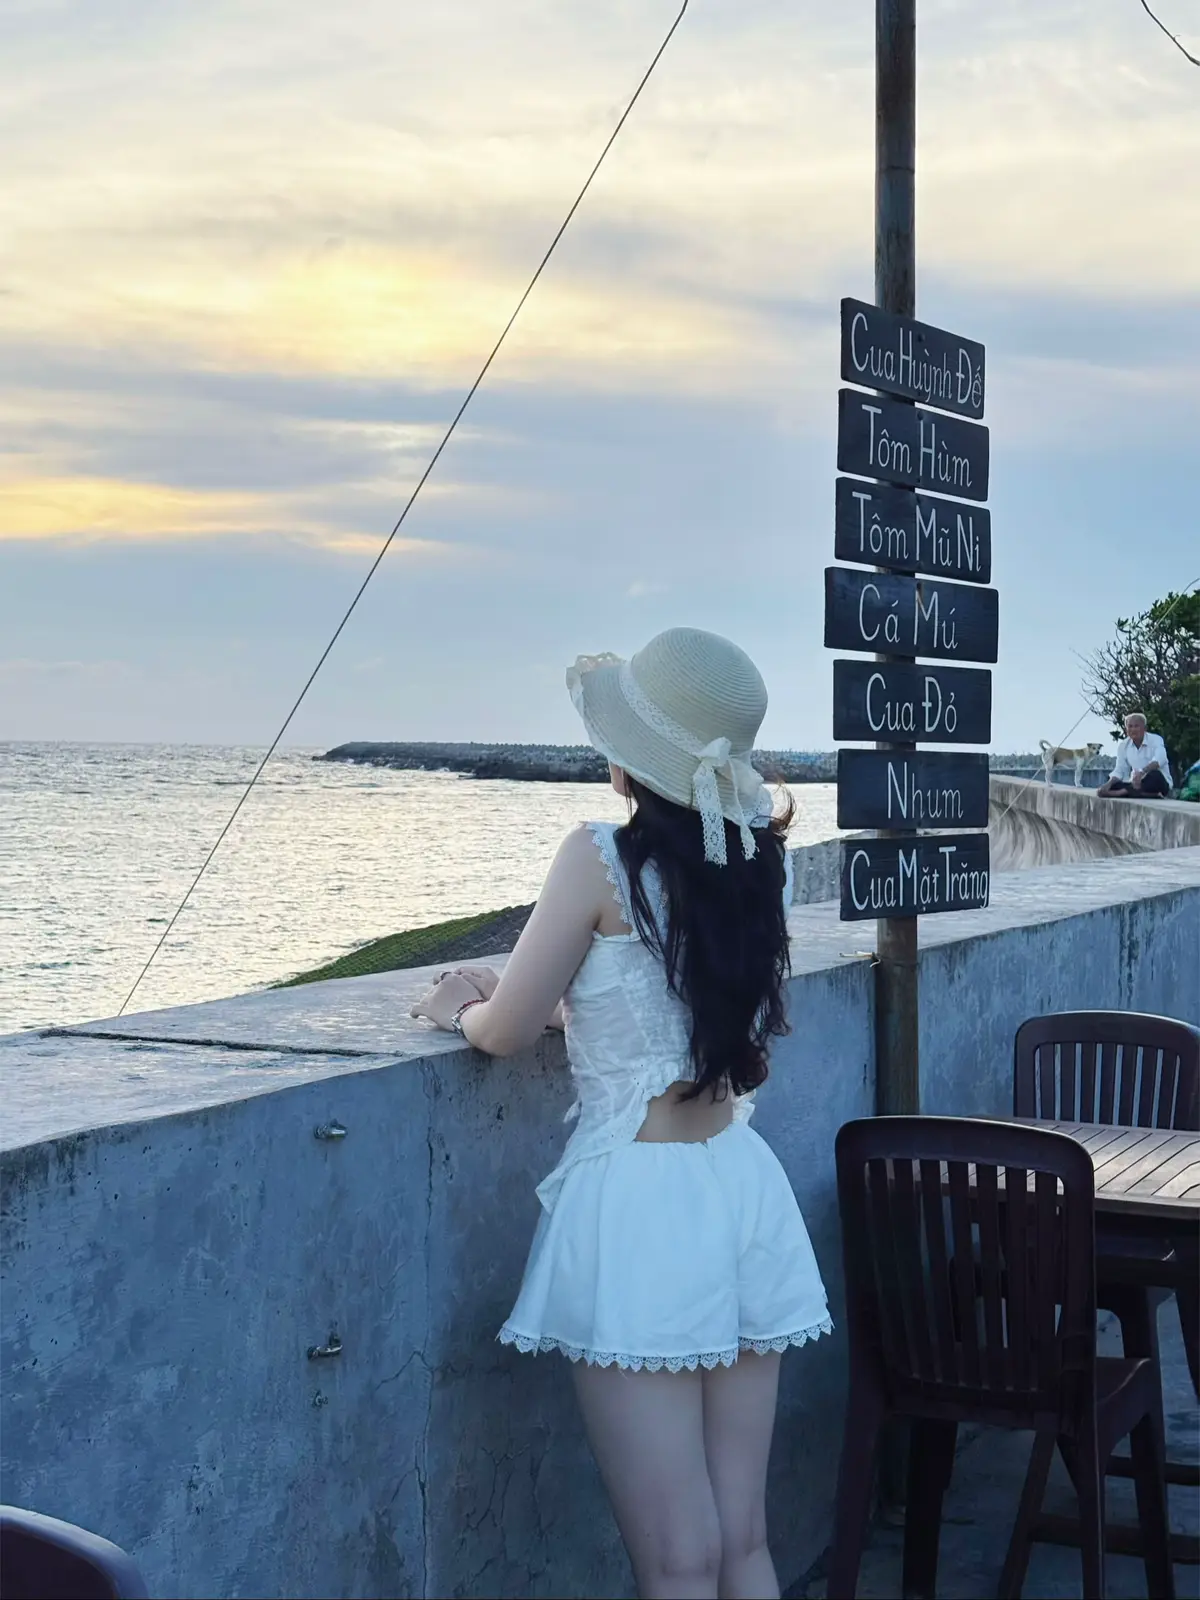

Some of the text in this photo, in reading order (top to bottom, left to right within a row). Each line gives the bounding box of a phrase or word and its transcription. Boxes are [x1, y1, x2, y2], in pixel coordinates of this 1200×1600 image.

[851, 312, 982, 408] Cua Huỳnh Đế
[861, 404, 973, 488] Tôm Hùm
[852, 491, 982, 572] Tôm Mũ Ni
[859, 583, 959, 649] Cá Mú
[866, 672, 957, 733] Cua Đỏ
[887, 761, 964, 819] Nhum
[850, 845, 988, 912] Cua Mặt Trăng
